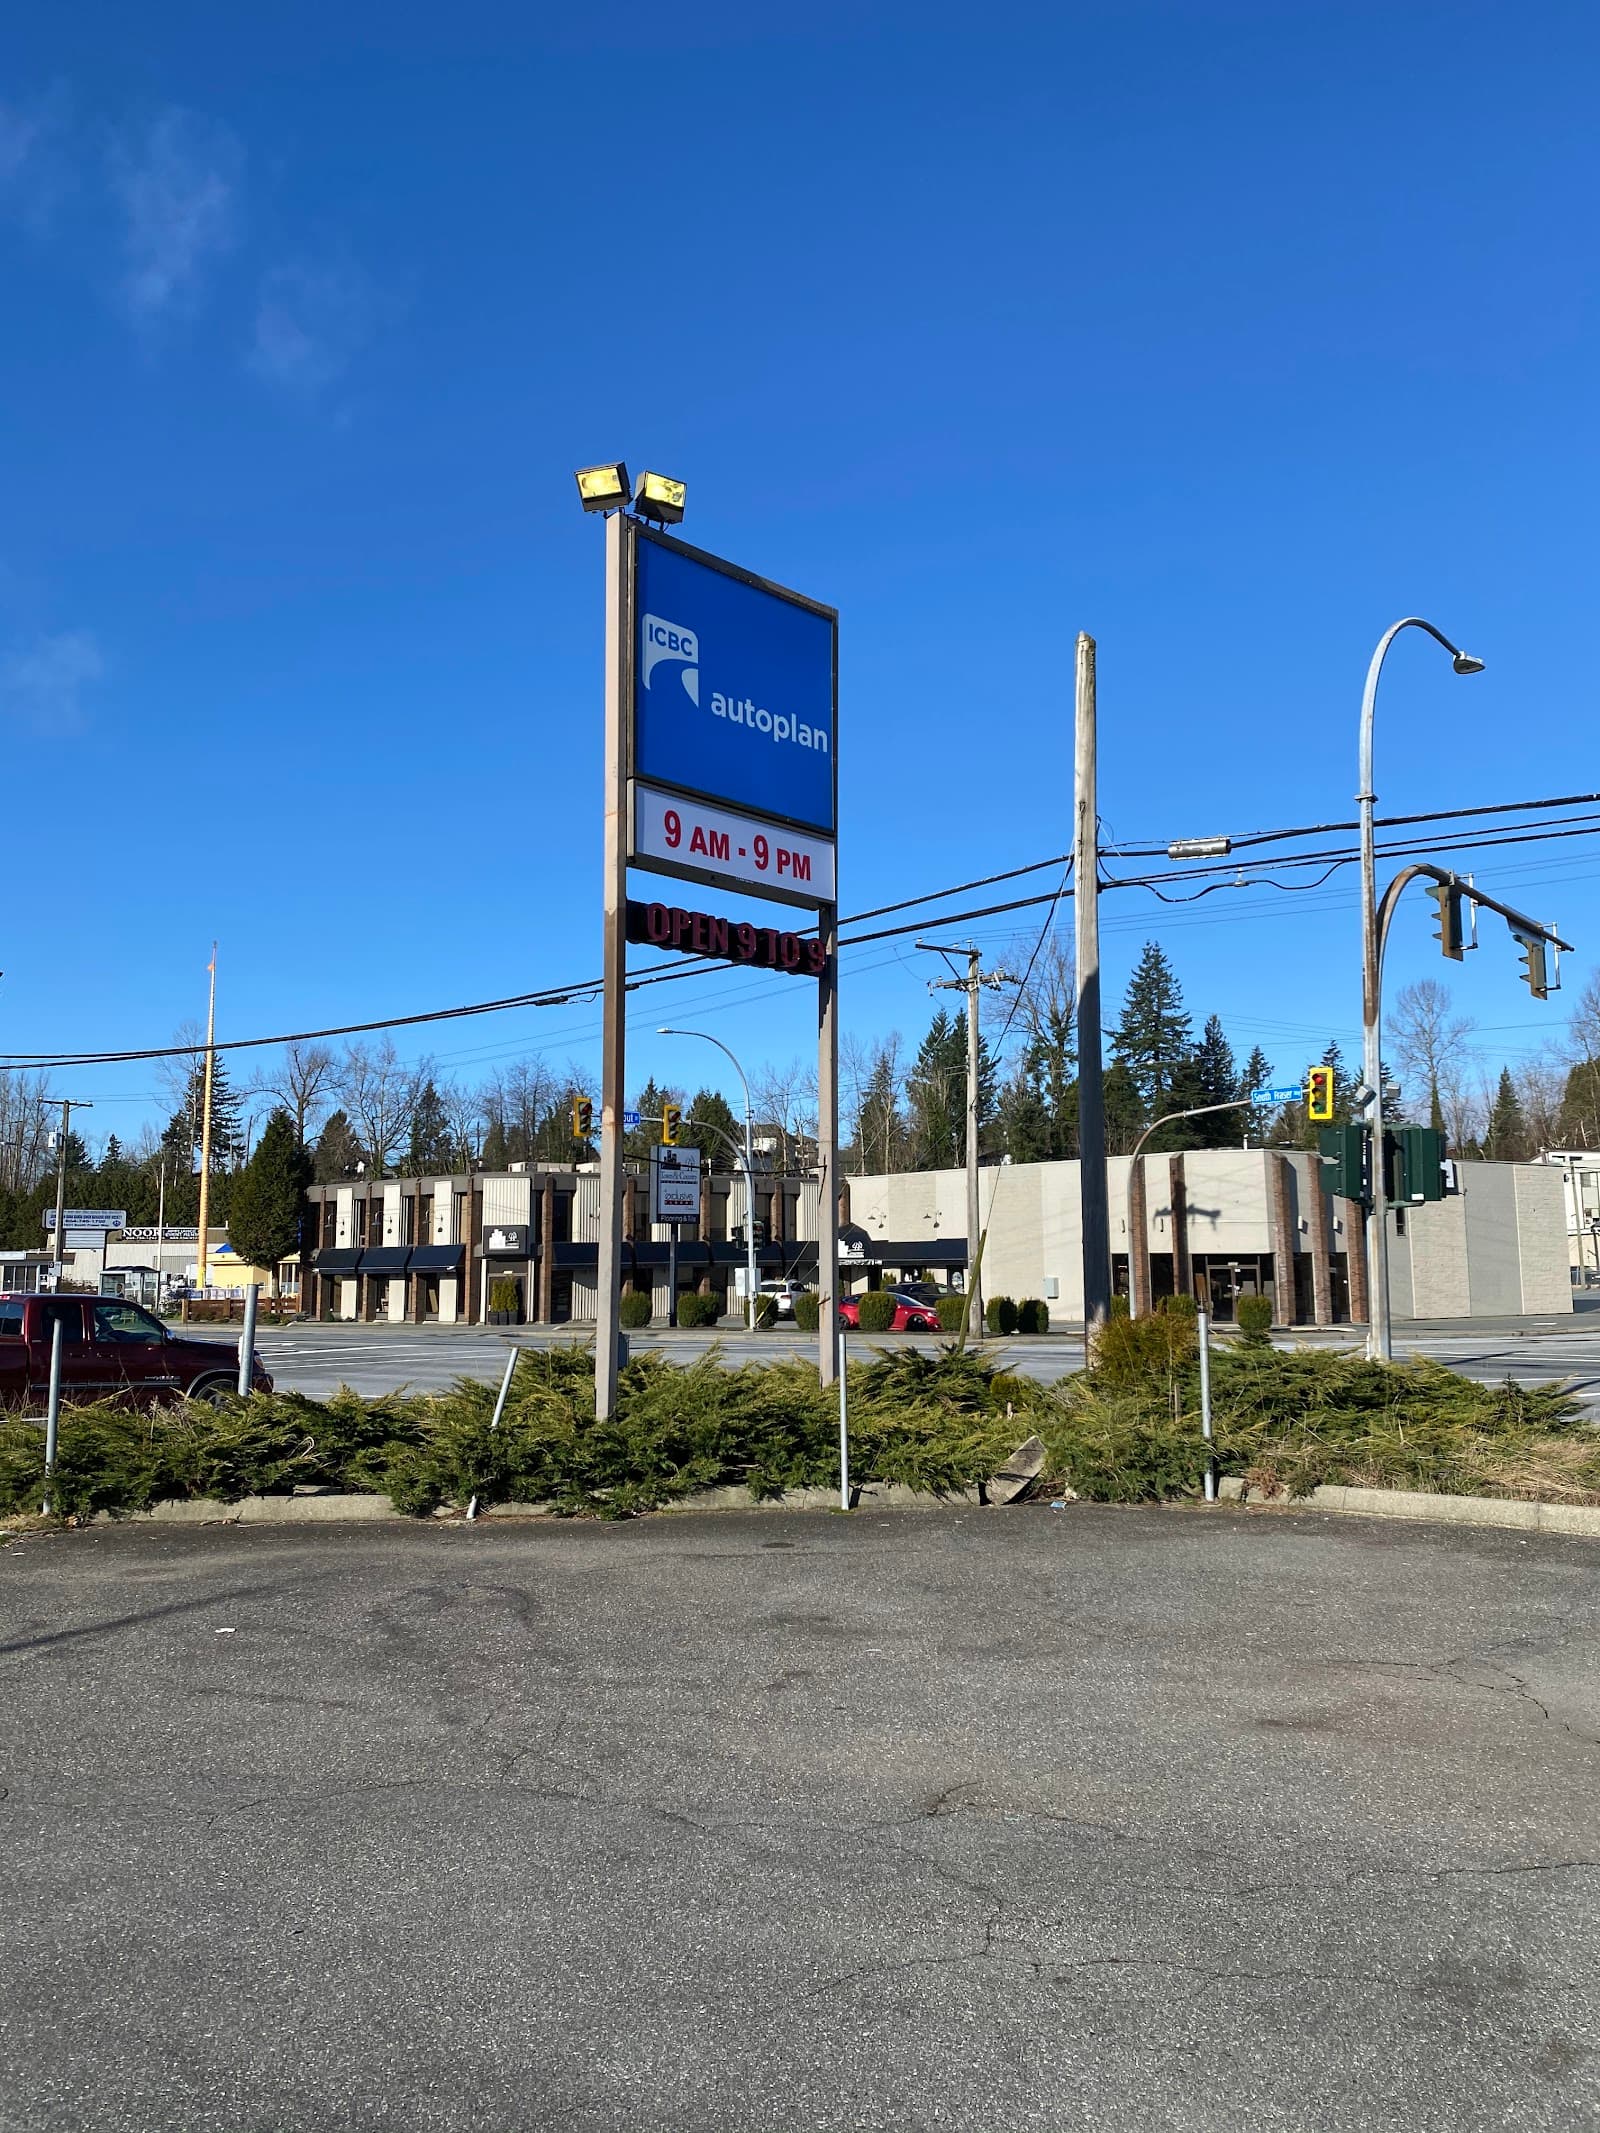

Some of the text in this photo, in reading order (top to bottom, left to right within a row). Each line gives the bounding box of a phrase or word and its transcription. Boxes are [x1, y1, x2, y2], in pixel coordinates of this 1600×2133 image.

[649, 623, 693, 657] ICBC
[710, 692, 828, 753] autoplan
[664, 810, 681, 848] 9
[689, 826, 730, 861] AM
[753, 835, 769, 870] 9
[777, 848, 811, 881] PM
[646, 902, 826, 973] OPEN 9 TO 9
[1253, 1092, 1271, 1102] South
[1273, 1090, 1292, 1100] Fraser
[660, 1215, 683, 1223] Flooring
